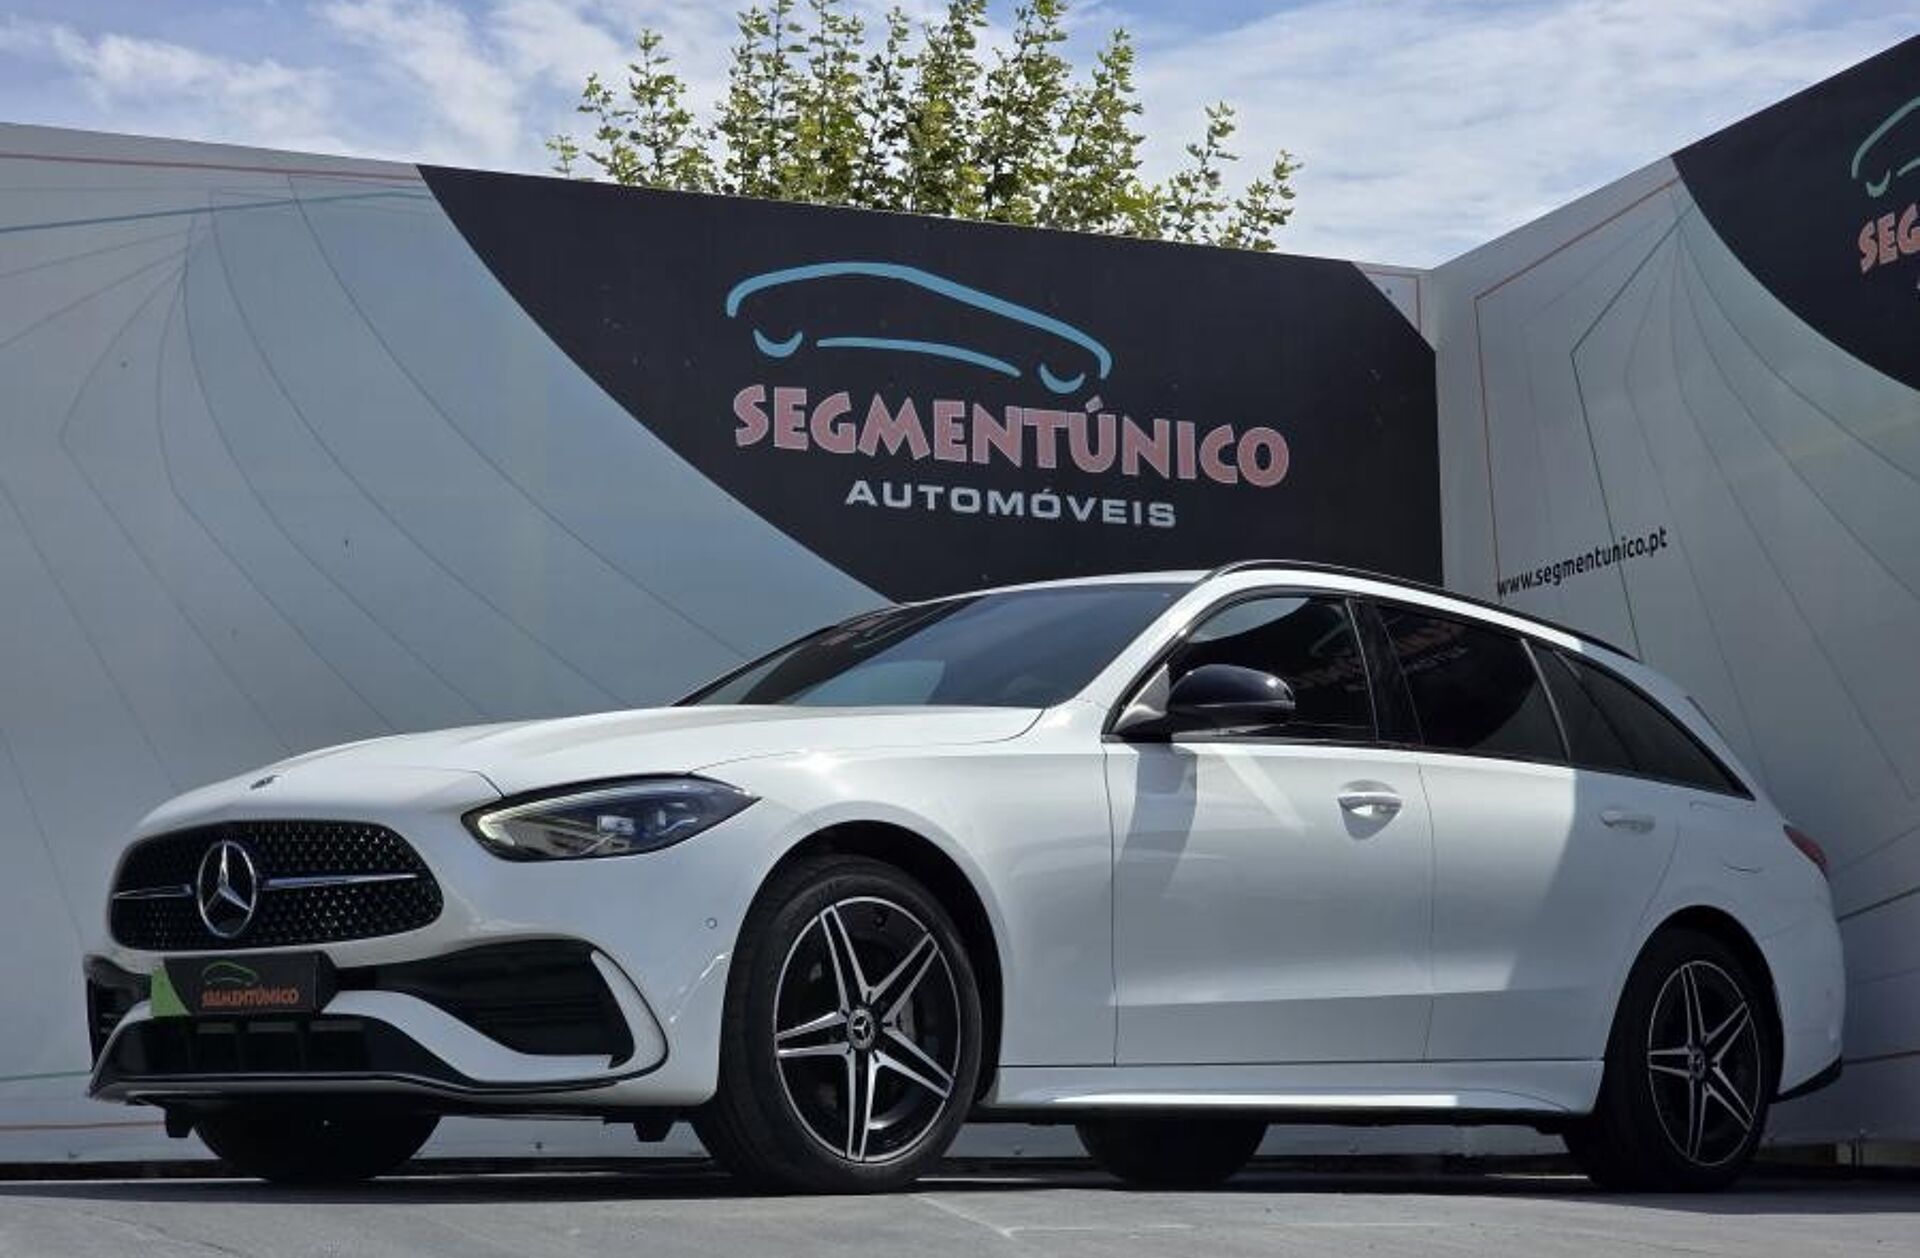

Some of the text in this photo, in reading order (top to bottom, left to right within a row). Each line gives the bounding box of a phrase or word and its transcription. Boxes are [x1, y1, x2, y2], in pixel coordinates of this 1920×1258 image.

[732, 384, 1290, 488] SEGMENTÚNICO
[846, 480, 1177, 528] AUTOMÓVEIS
[1497, 526, 1668, 597] www.segmentunico.pt
